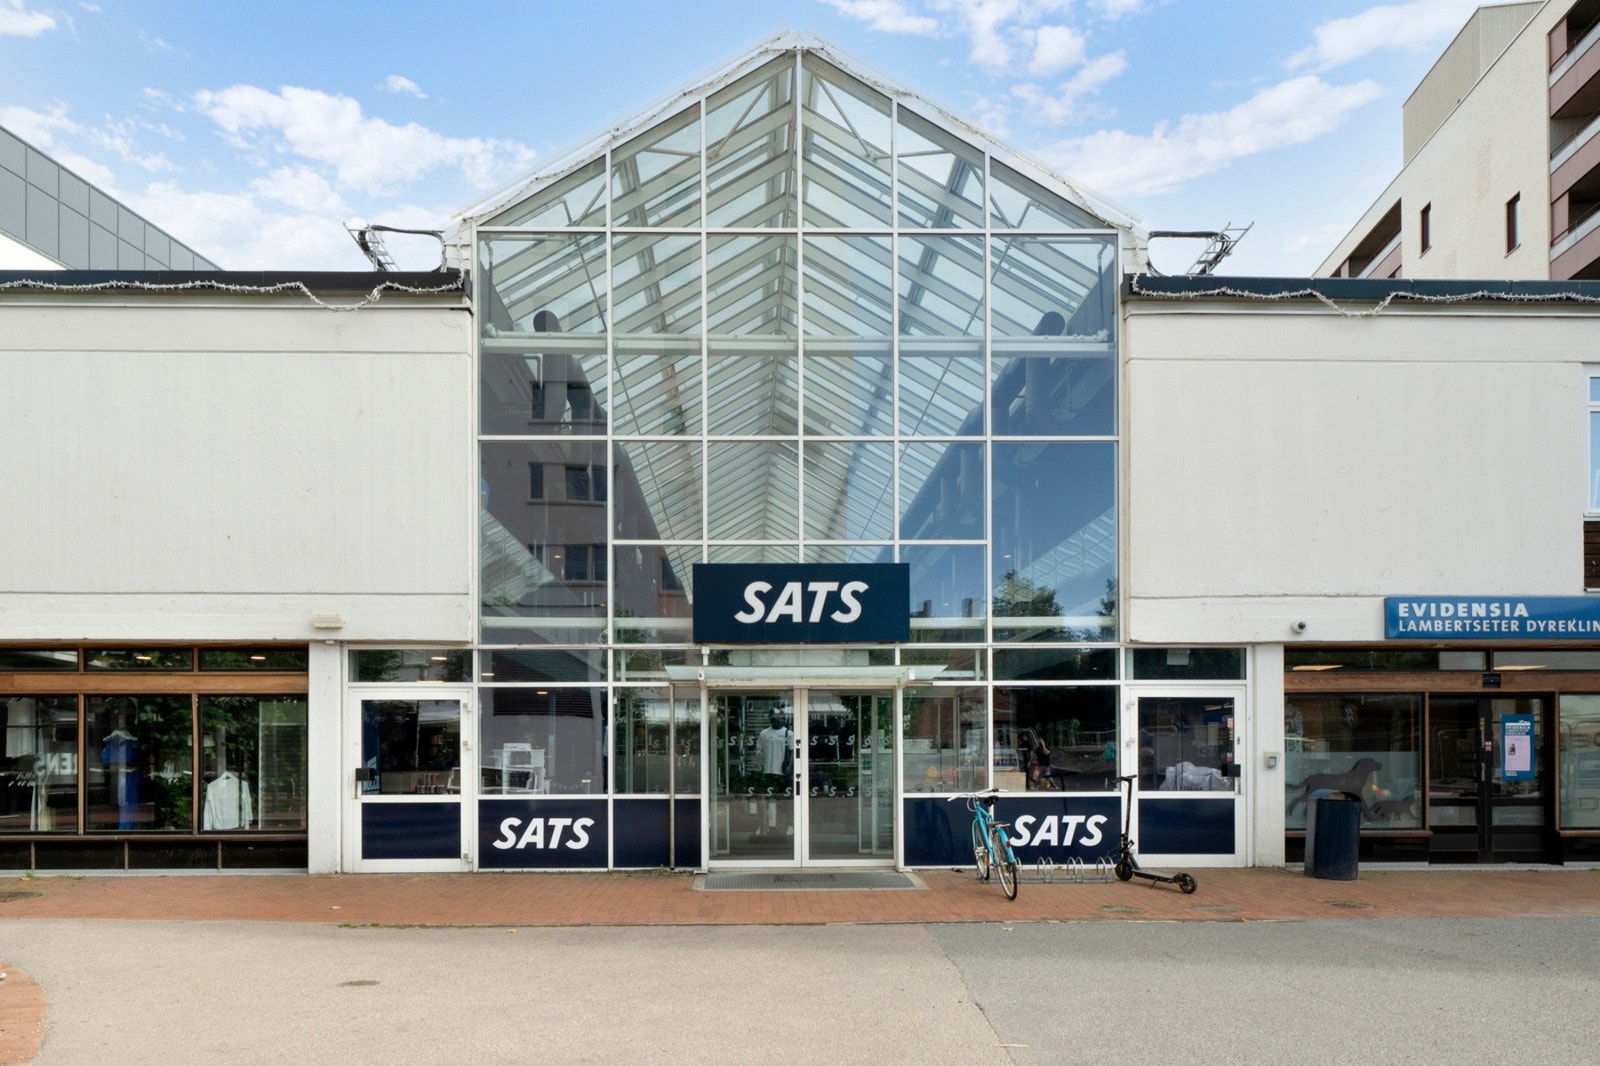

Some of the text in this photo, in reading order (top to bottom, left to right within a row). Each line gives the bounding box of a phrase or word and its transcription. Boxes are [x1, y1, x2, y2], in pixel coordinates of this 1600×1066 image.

[734, 580, 870, 624] SATS
[1398, 602, 1529, 618] EVIDENSIA
[1399, 619, 1519, 632] LAMBERTSETER
[492, 817, 595, 850] SATS
[1009, 814, 1108, 847] SATS
